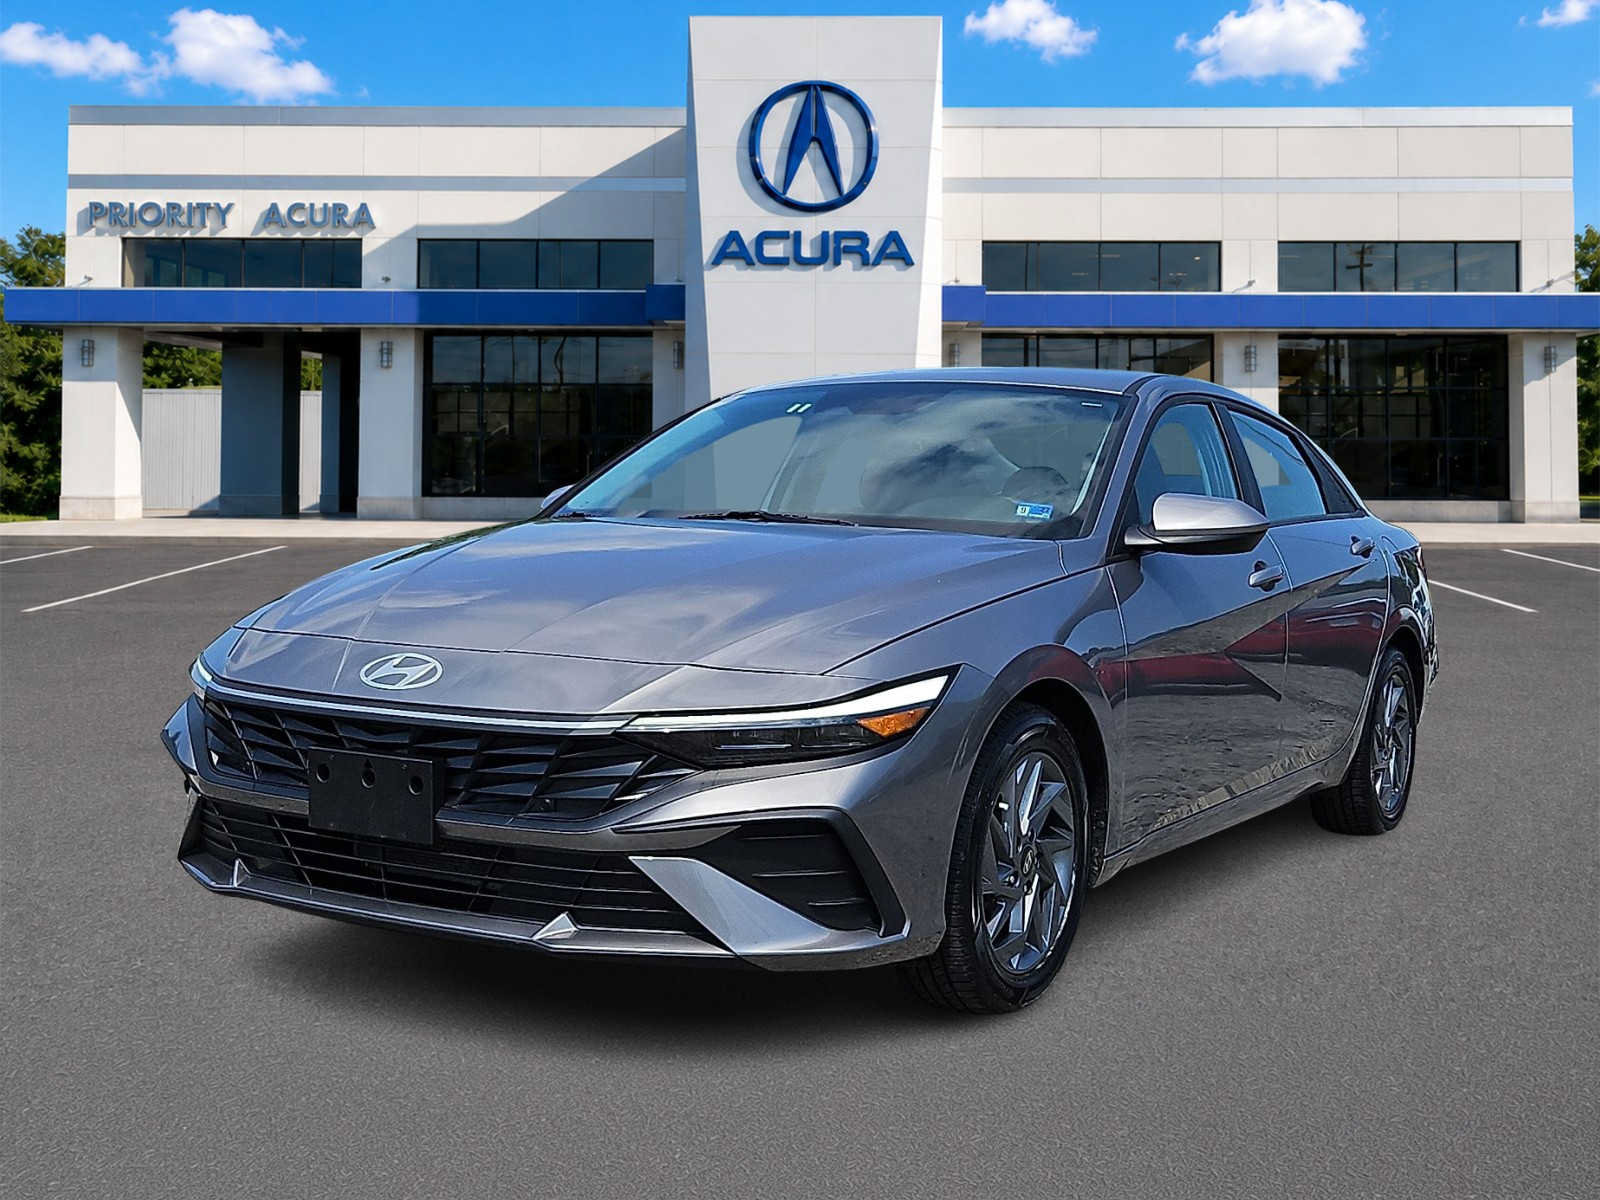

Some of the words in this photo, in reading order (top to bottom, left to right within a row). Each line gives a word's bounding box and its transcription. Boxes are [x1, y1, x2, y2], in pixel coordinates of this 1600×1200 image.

[88, 201, 235, 229] PRIORITY
[262, 201, 377, 229] ACURA
[711, 230, 915, 267] ACURA
